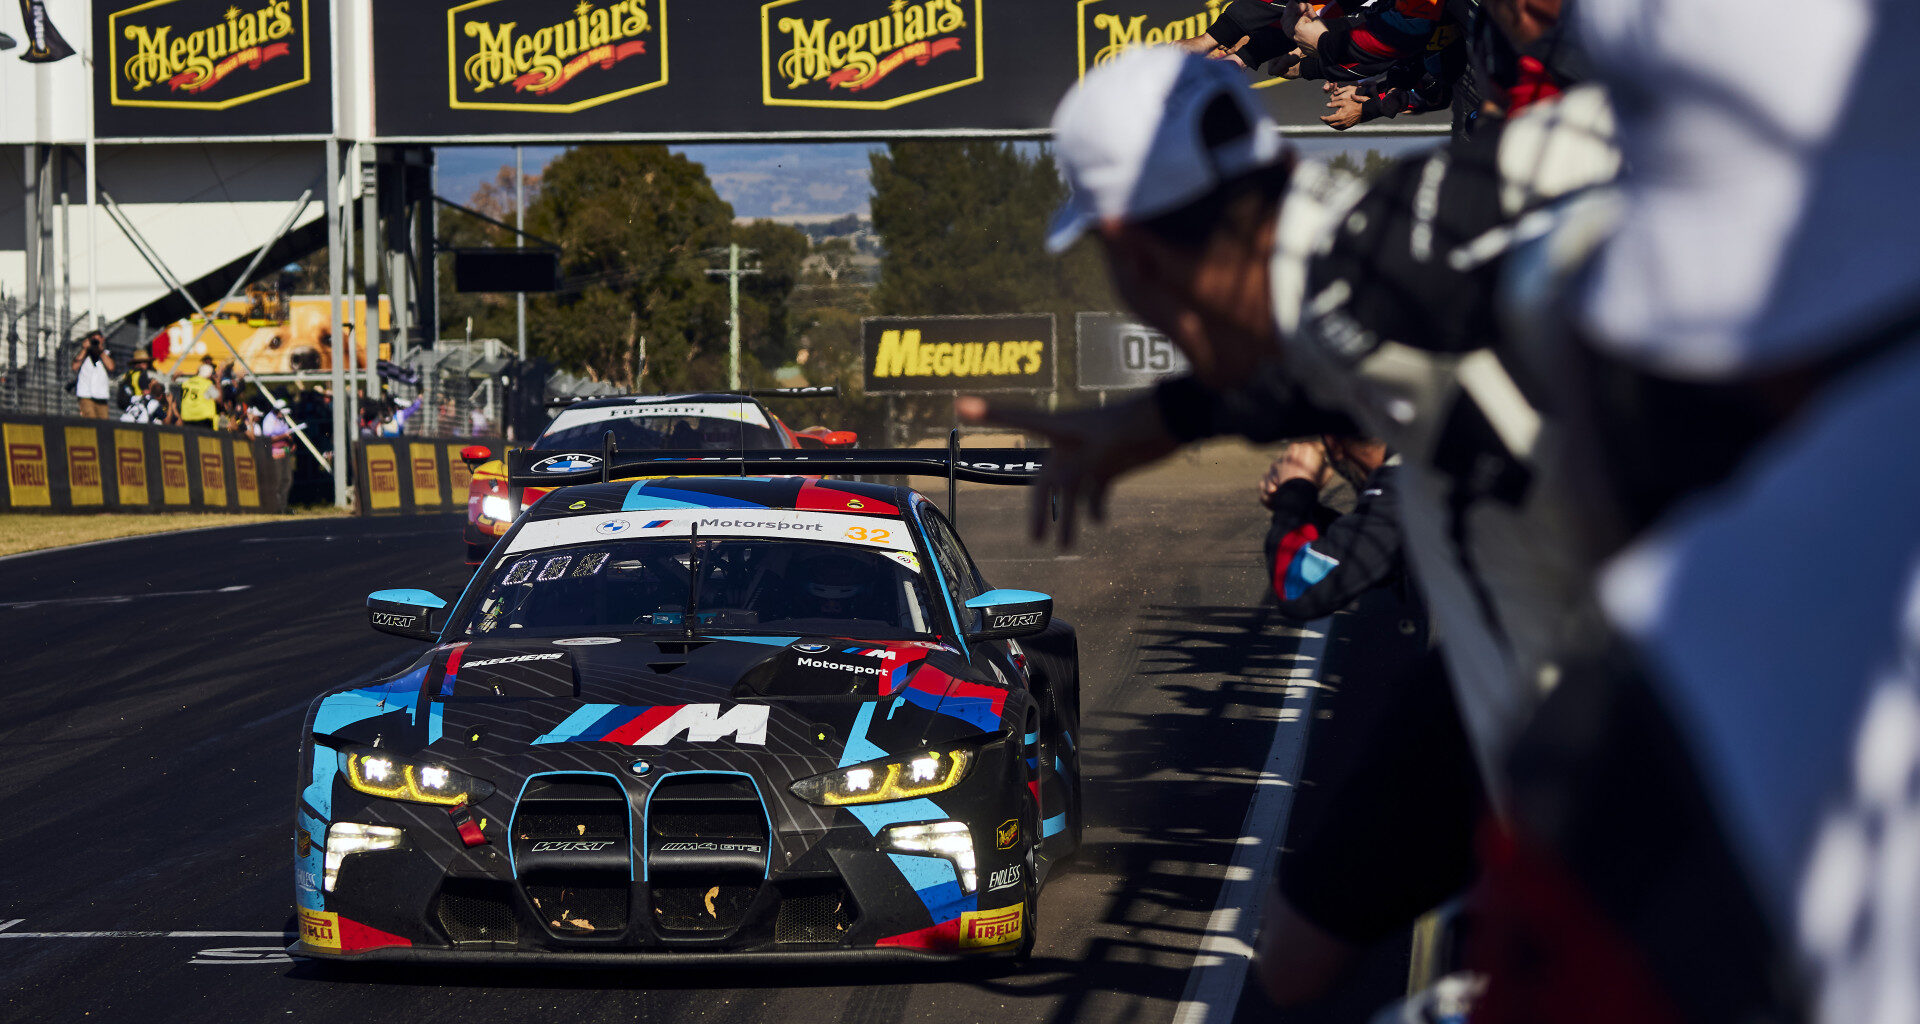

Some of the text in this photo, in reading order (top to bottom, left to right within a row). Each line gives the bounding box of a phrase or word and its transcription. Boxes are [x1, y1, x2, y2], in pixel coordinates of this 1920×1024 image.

[125, 0, 292, 91] Meguiar's
[464, 0, 649, 93] Meguiars
[778, 0, 964, 89] Meguiars
[1094, 0, 1233, 68] Megui
[873, 328, 1043, 377] MEGUIAR'S
[609, 406, 705, 417] Ferrari
[9, 443, 46, 486] PIRELLI
[69, 446, 99, 486] PIRELLI
[371, 460, 396, 491] PIRELLI
[700, 517, 824, 532] Motorsport
[847, 526, 891, 544] 32
[372, 611, 416, 628] WRT
[993, 611, 1043, 628] WRT
[462, 652, 565, 669] SKECHERS
[797, 657, 889, 677] Motorsport
[532, 841, 615, 852] WRT
[720, 843, 762, 853] GT3
[989, 864, 1021, 889] ENDLESS
[967, 910, 1020, 939] PIRELLI
